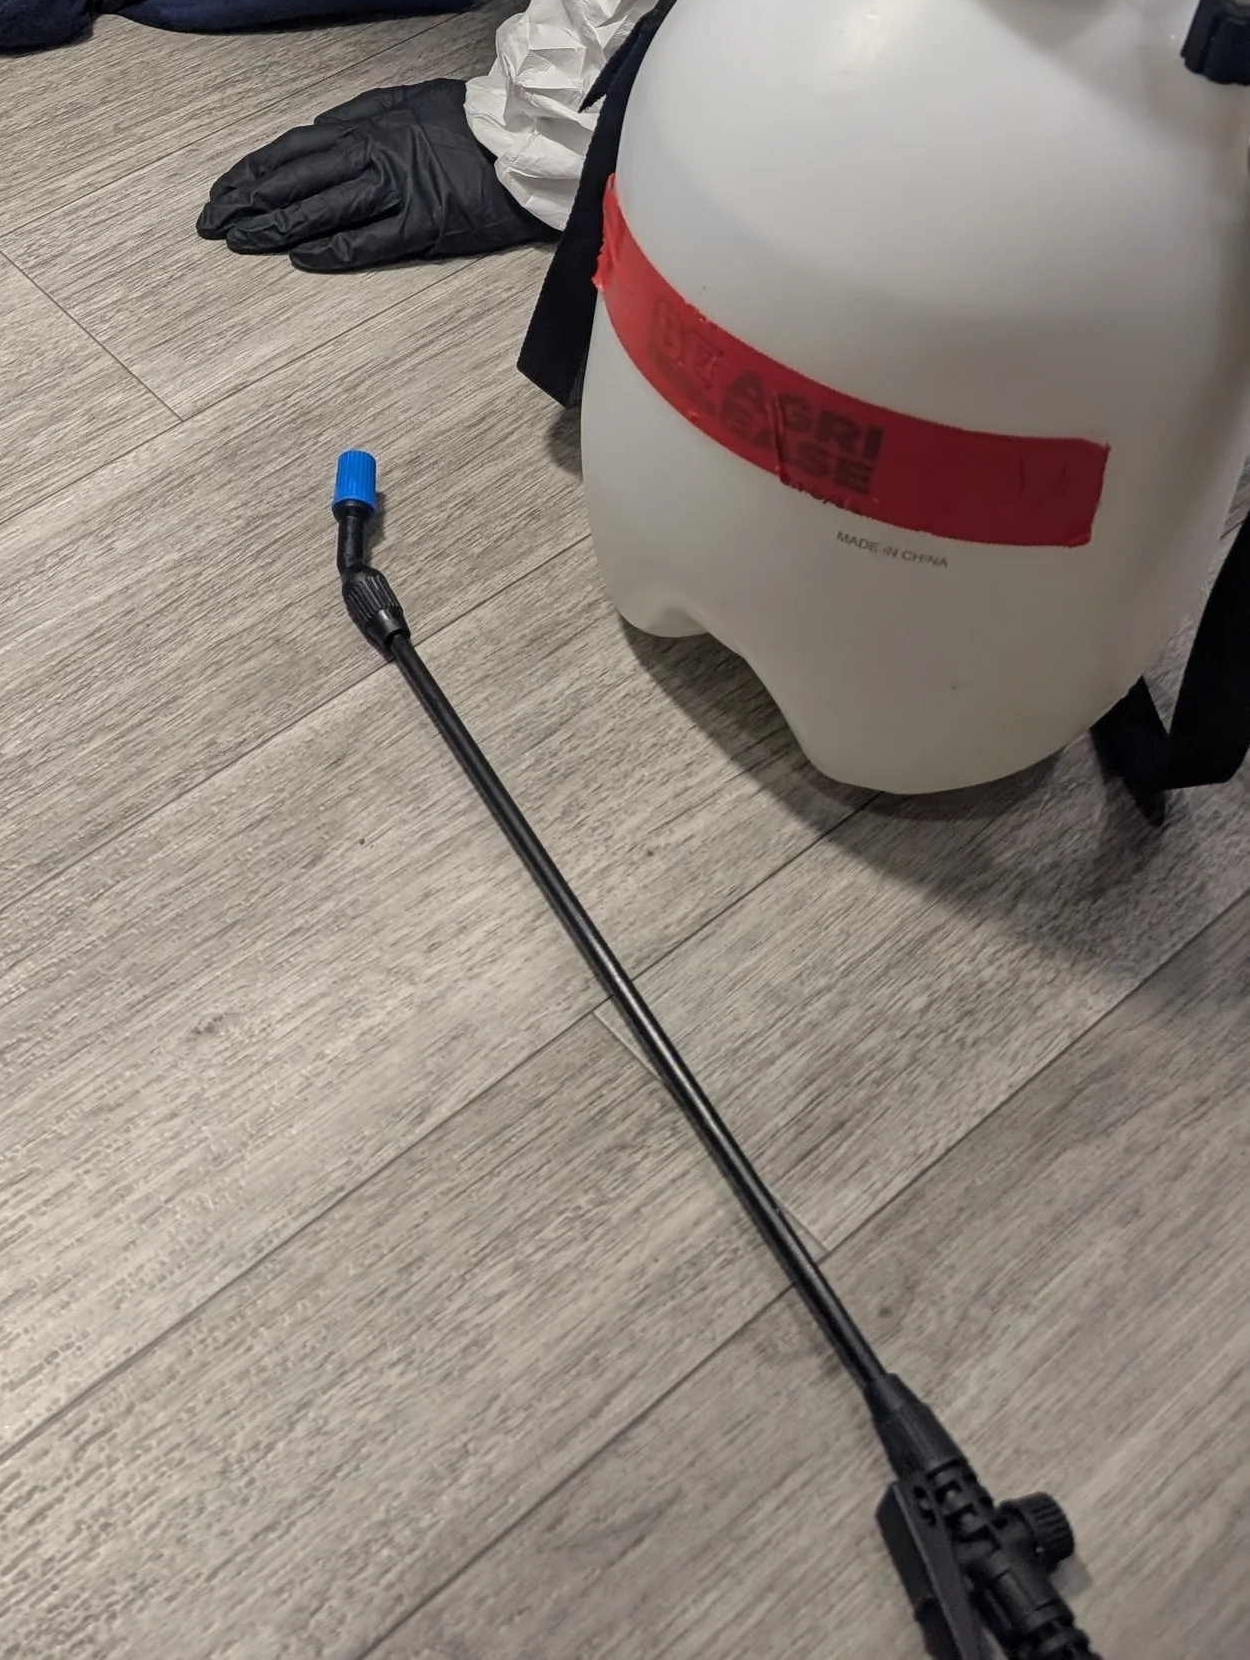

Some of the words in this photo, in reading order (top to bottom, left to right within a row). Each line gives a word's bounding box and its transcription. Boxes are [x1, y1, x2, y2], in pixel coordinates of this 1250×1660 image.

[836, 531, 879, 552] MADE
[883, 546, 899, 558] IN
[901, 549, 949, 568] CHINA
